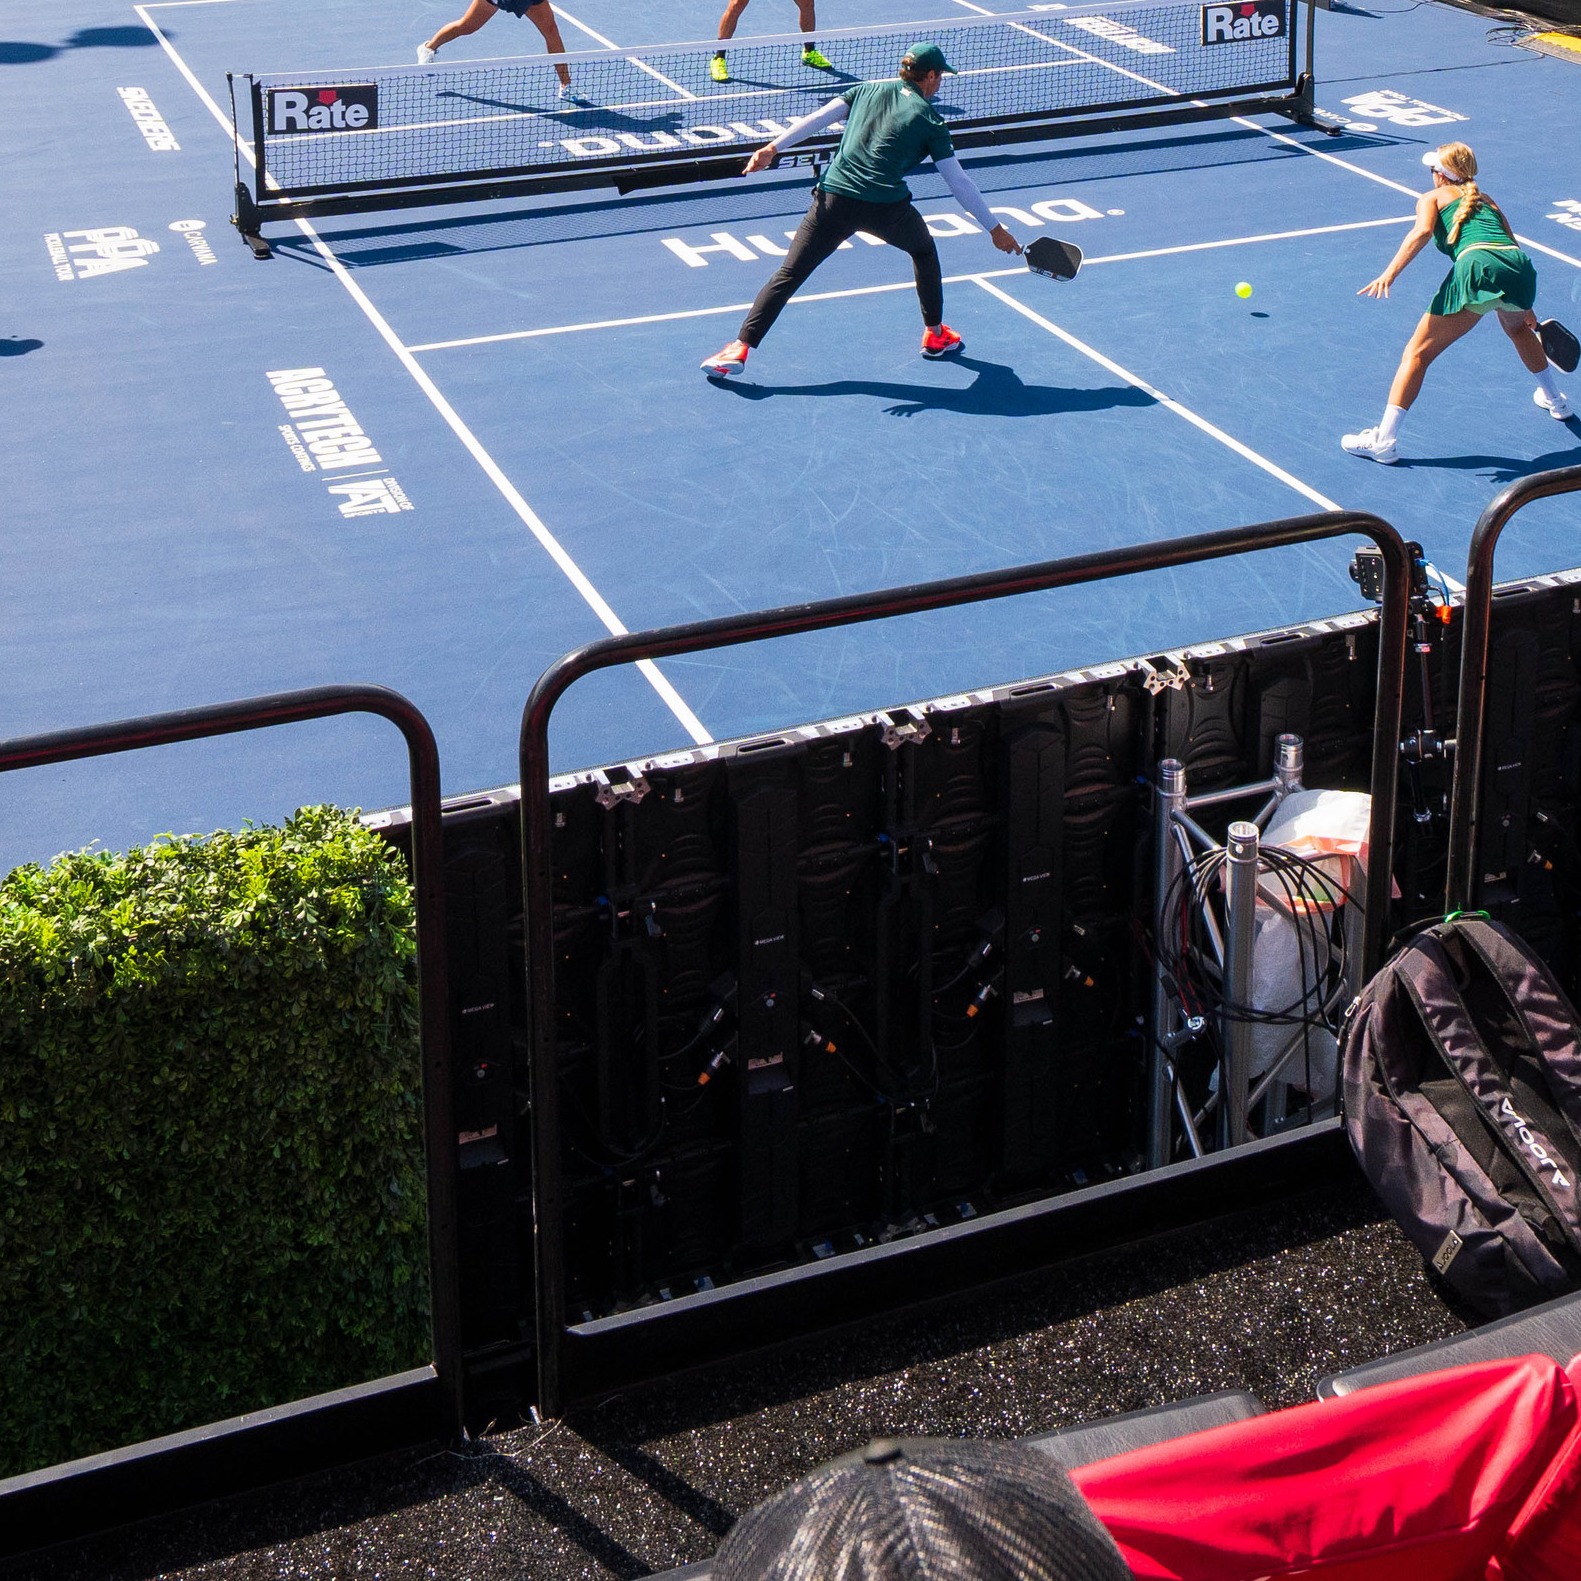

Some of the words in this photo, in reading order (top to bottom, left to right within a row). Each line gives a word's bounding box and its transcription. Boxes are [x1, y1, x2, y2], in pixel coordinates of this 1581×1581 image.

[1206, 7, 1280, 43] Rate
[274, 92, 369, 132] Rate
[62, 226, 160, 279] PPA
[183, 230, 218, 266] CARVANA
[265, 367, 383, 470] ACRYTECH
[277, 424, 301, 445] SPORTS
[289, 444, 317, 473] COATINGS
[382, 477, 410, 504] DIVISION
